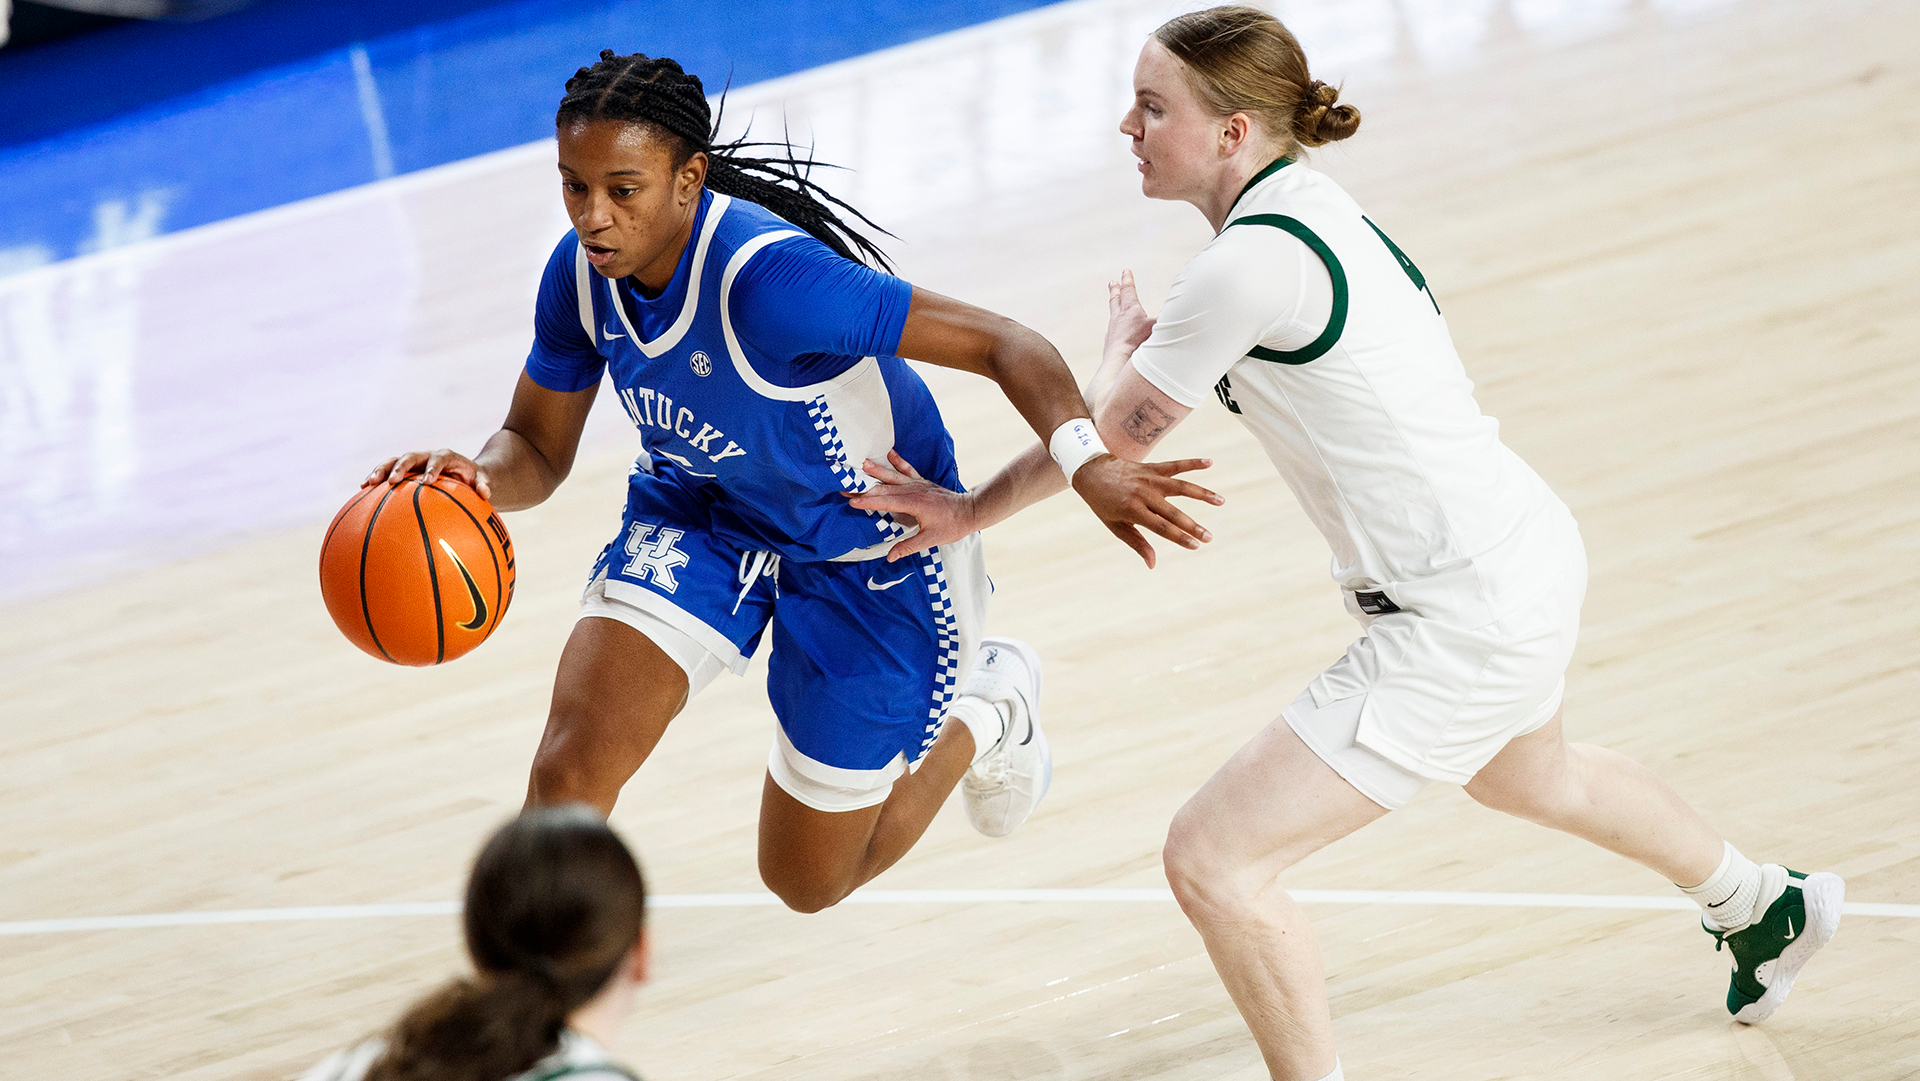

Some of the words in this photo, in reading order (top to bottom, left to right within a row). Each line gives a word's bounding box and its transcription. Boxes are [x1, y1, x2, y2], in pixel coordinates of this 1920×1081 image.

[691, 353, 711, 375] SEC
[620, 386, 747, 463] NTUCKY
[621, 520, 690, 595] UK
